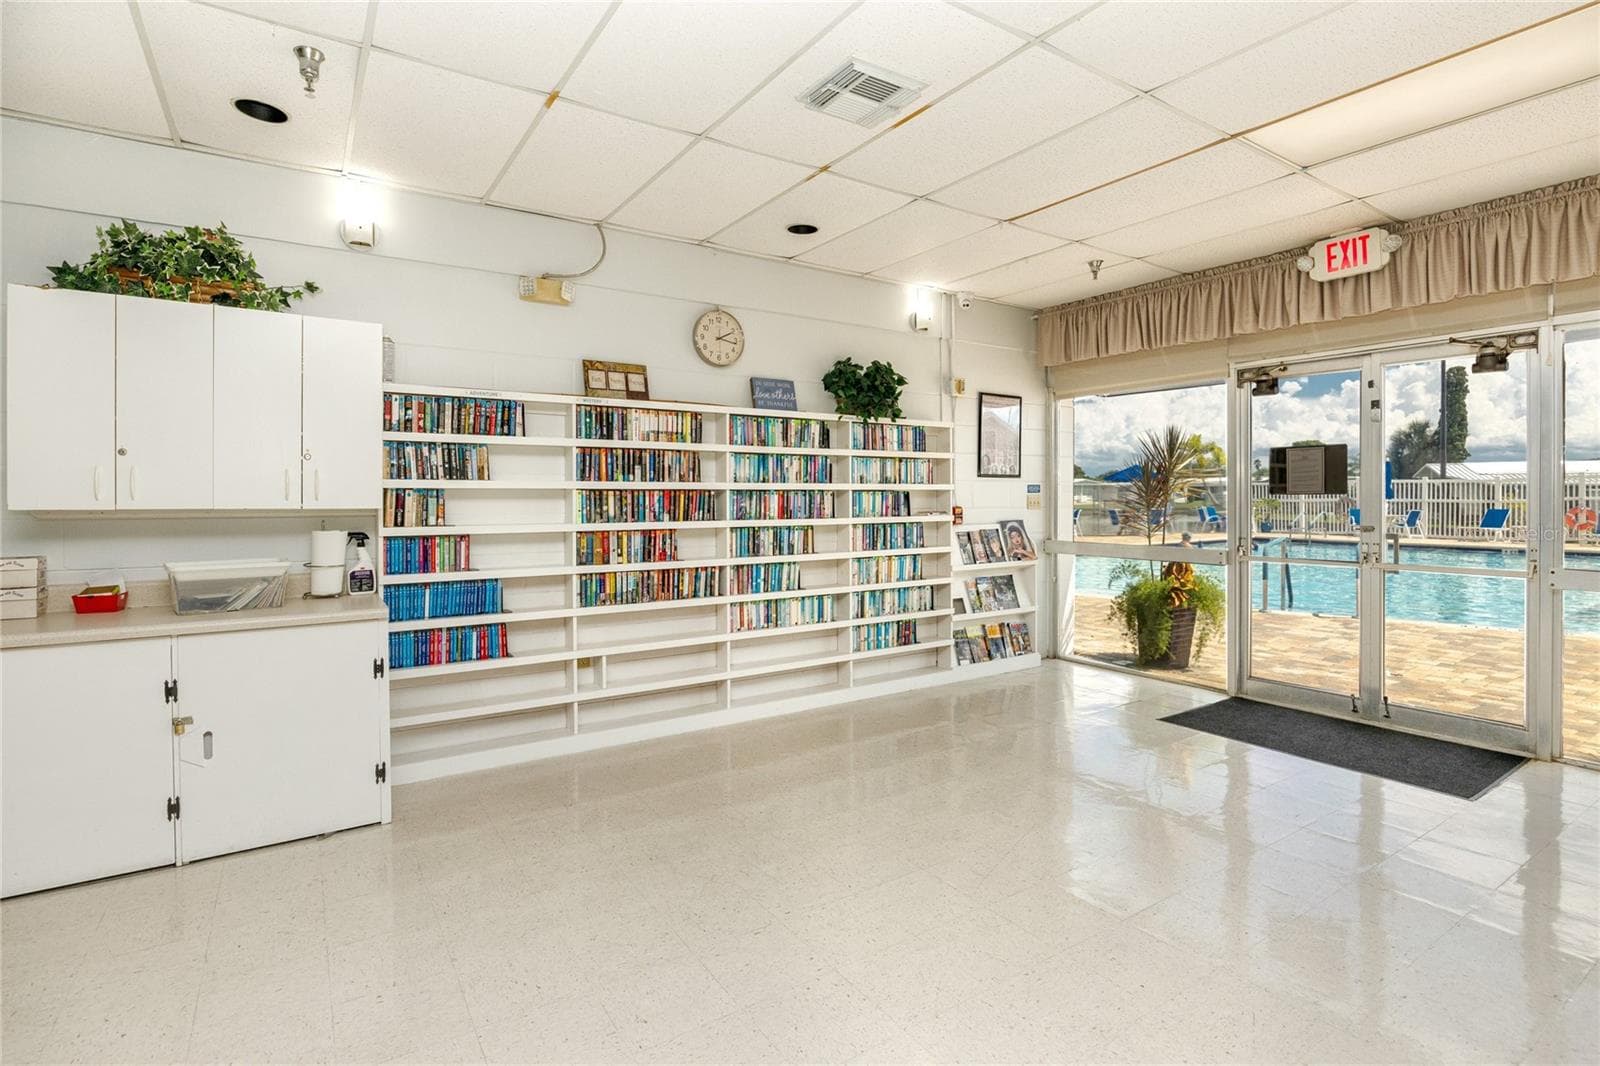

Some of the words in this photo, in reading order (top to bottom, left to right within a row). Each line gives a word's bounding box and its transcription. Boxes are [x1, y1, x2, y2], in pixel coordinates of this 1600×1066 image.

[1326, 234, 1370, 273] EXIT
[715, 316, 722, 324] 12
[469, 389, 498, 397] ADVENTURE
[753, 386, 770, 399] love
[771, 388, 797, 401] others
[767, 400, 793, 409] THANKFUL
